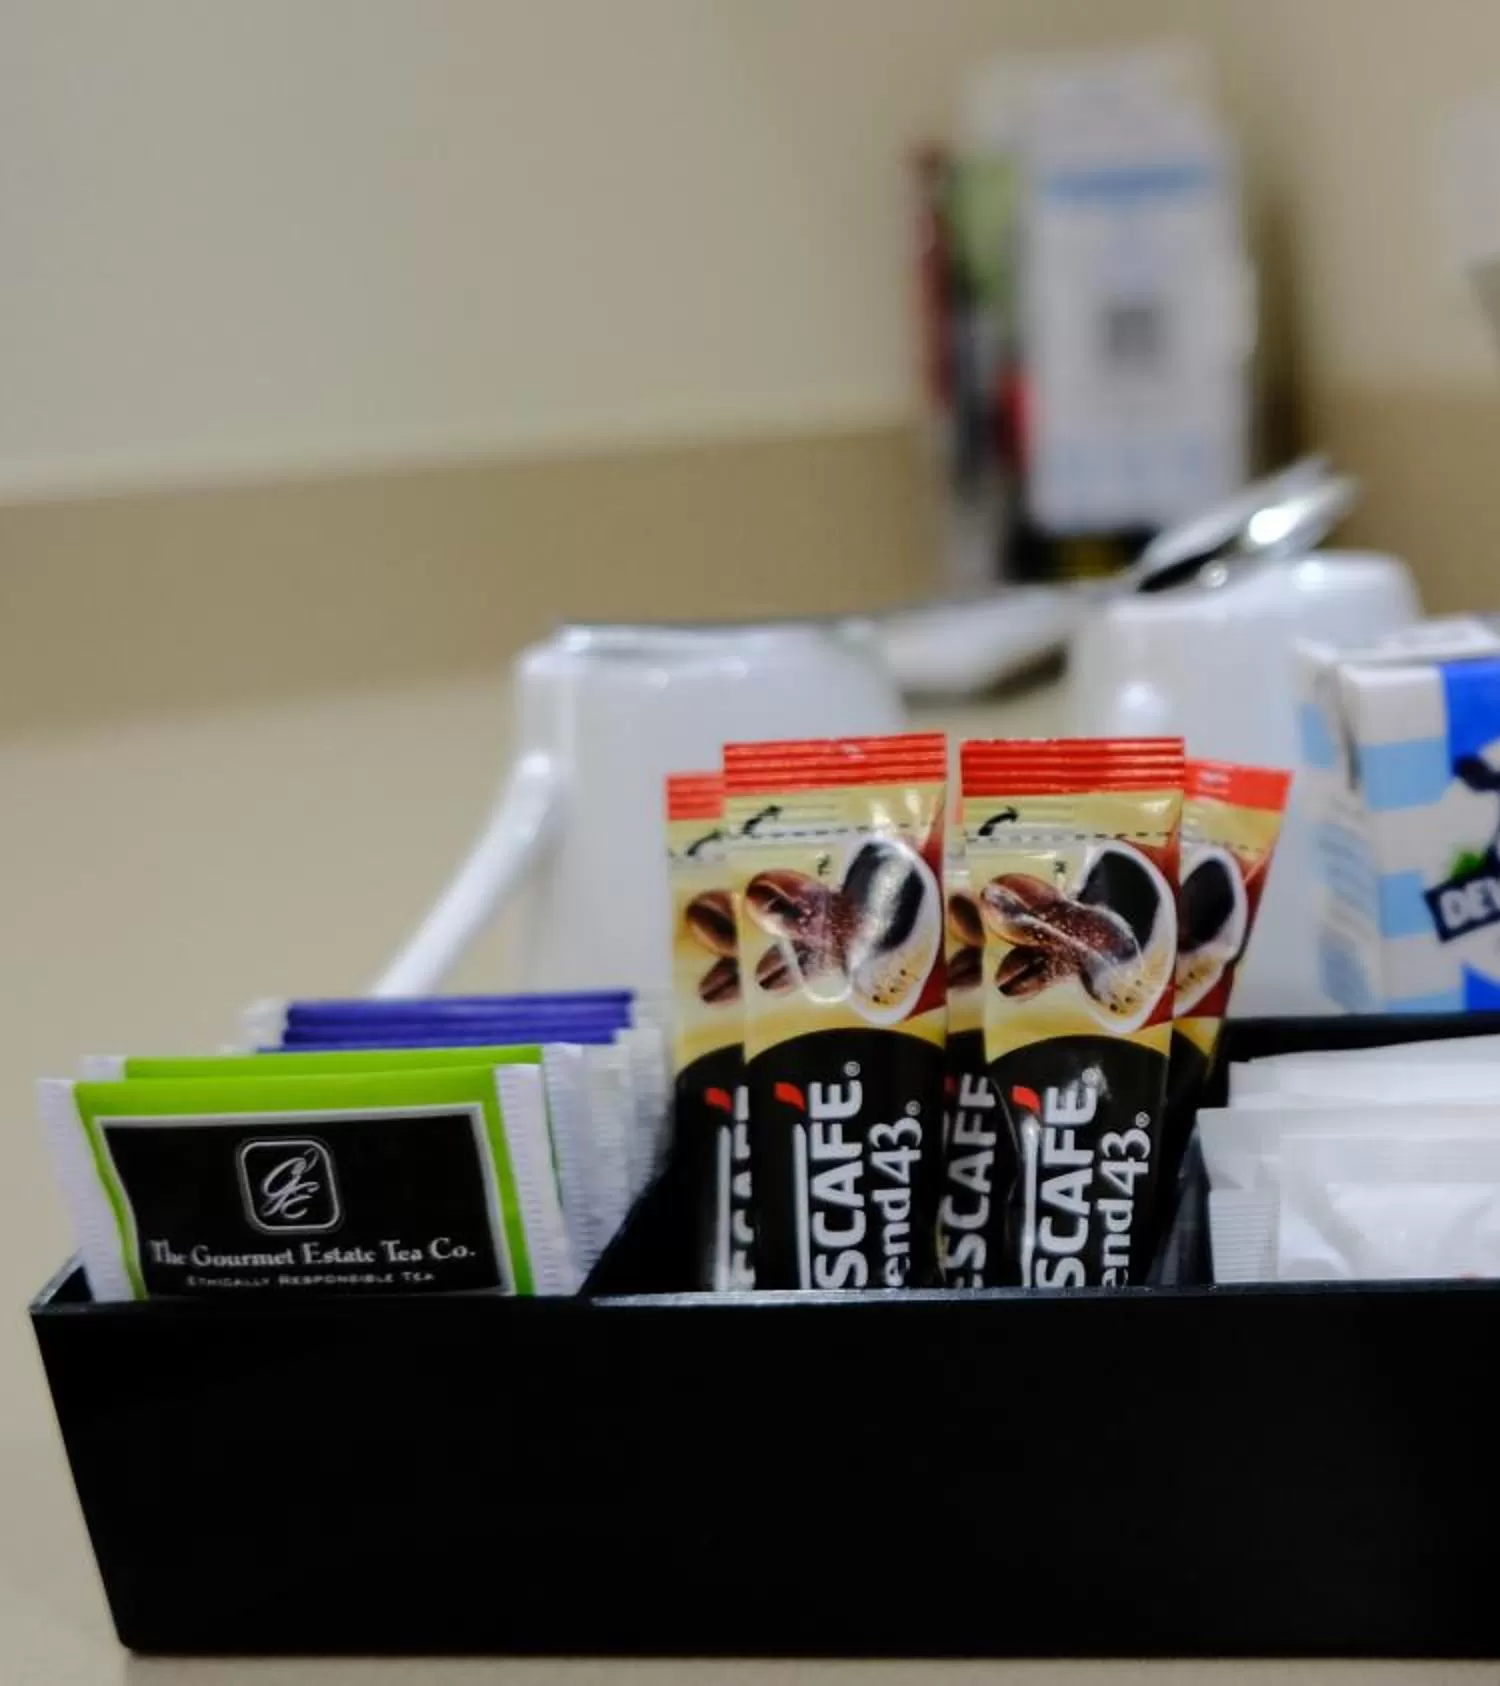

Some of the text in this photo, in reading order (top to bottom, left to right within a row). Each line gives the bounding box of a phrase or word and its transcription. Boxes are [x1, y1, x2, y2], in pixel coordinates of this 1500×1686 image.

[150, 1236, 476, 1268] The Gourmet Estate Tea Co.
